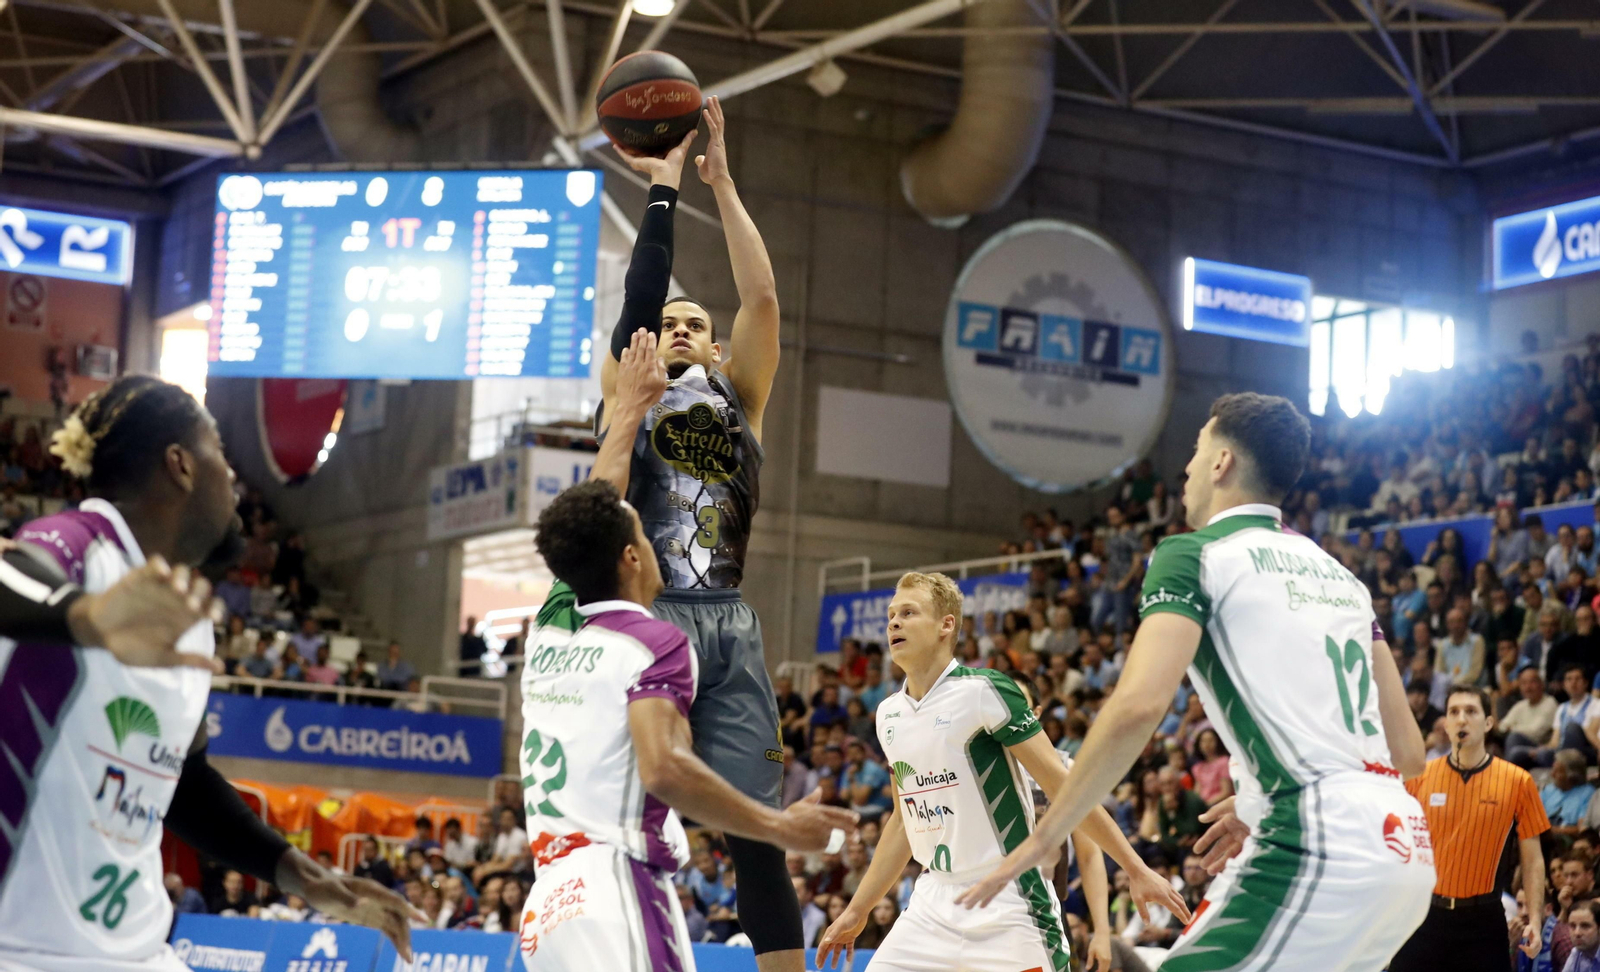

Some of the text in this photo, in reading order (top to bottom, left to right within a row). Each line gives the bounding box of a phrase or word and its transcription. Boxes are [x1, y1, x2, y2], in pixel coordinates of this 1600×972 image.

[666, 423, 733, 457] Estrella
[671, 440, 726, 471] Glicia
[697, 506, 719, 548] 3
[1325, 634, 1379, 737] 12
[915, 768, 957, 787] Unicaja
[904, 797, 955, 825] Málaga
[79, 863, 140, 930] 26
[558, 894, 585, 909] SOL
